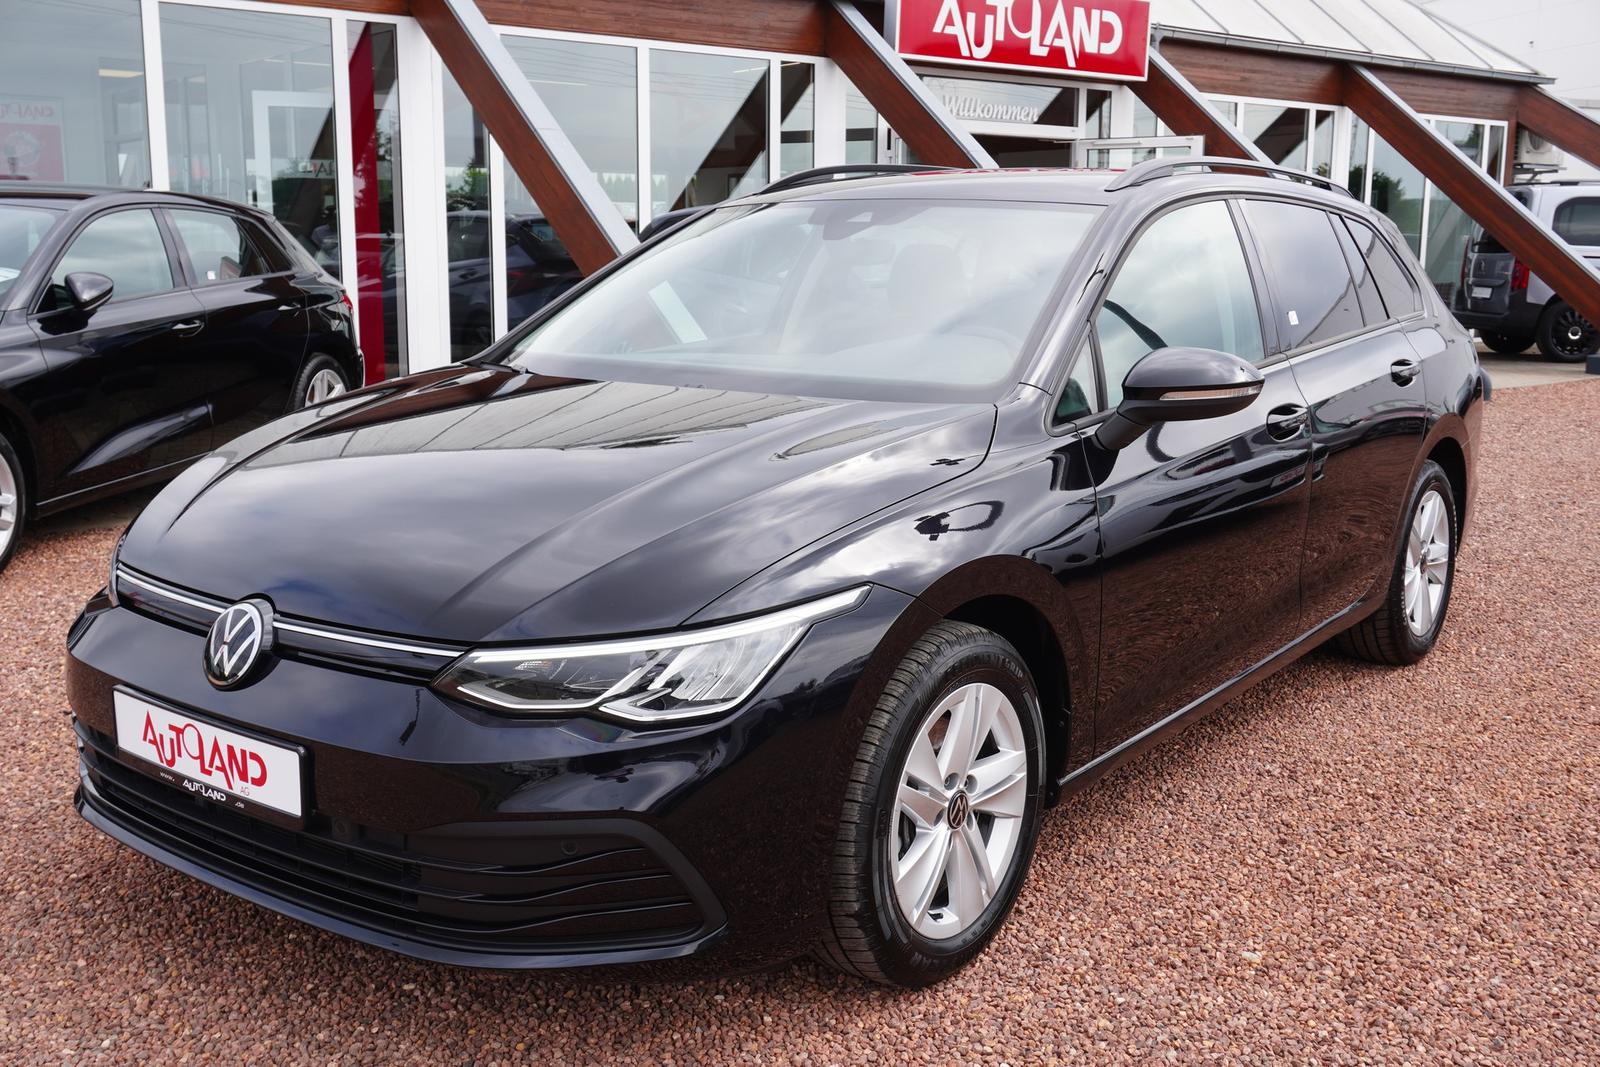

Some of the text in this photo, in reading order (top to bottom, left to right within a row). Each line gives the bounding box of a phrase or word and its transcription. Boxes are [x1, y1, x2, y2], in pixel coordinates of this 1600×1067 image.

[932, 0, 1123, 68] AUTOLAND
[942, 95, 1039, 122] Willkommen
[142, 710, 267, 791] AUTOLAND
[182, 779, 227, 801] AUTOLAND
[240, 786, 250, 797] AG
